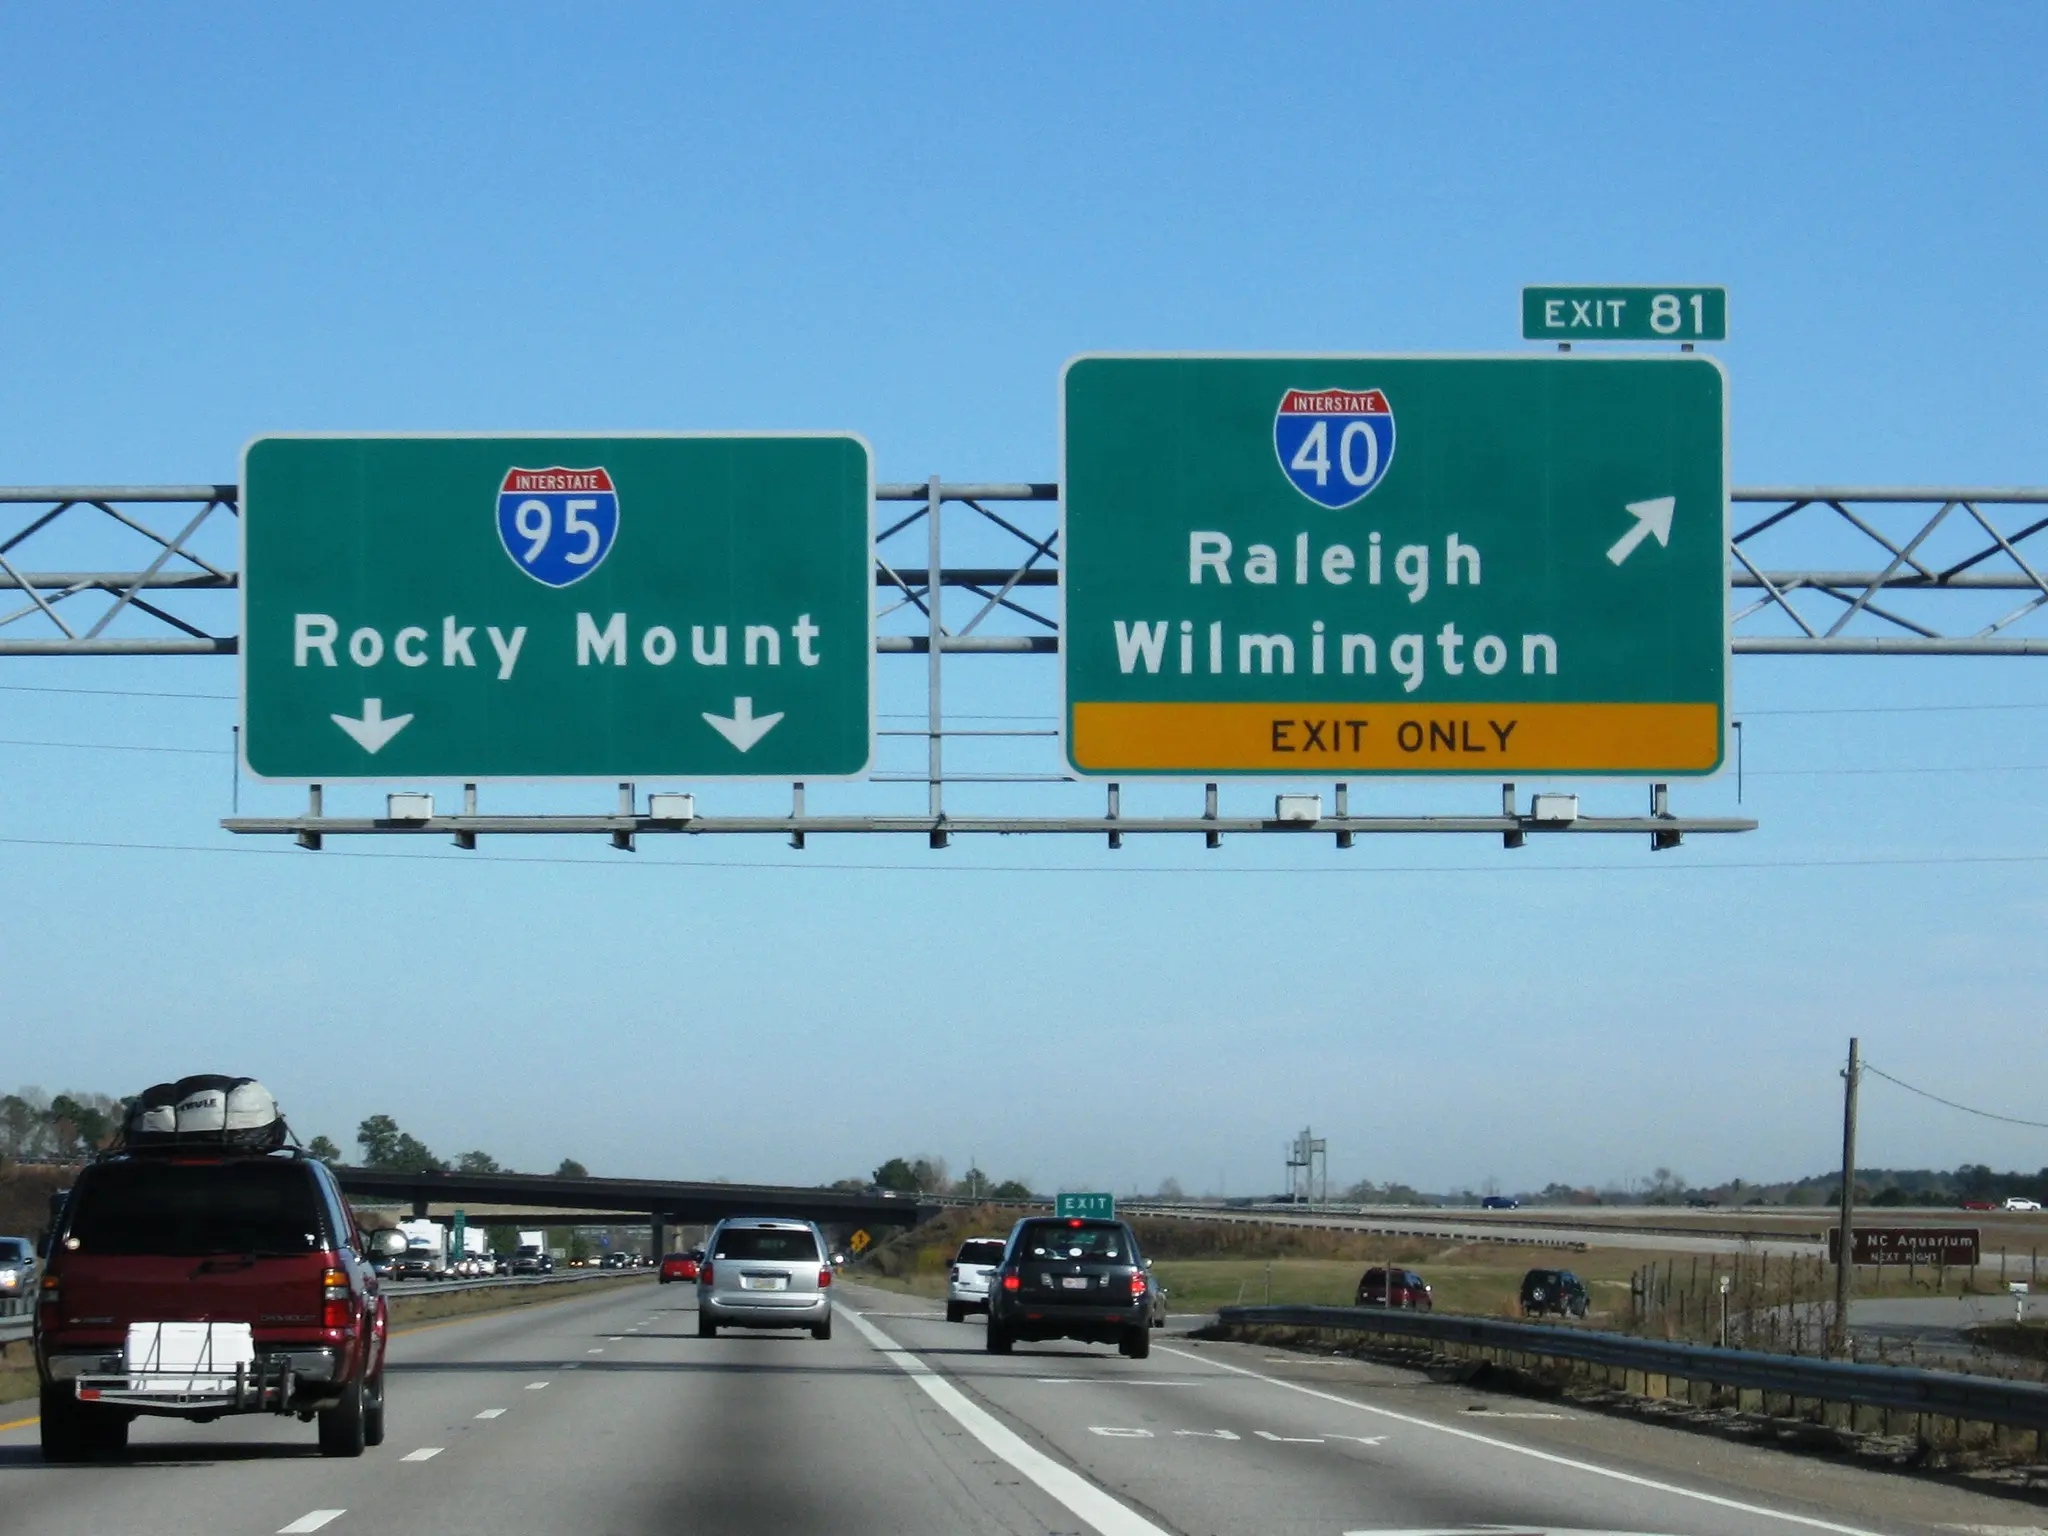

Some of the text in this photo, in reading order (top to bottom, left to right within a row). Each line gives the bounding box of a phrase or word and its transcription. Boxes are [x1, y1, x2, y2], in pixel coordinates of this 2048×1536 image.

[1544, 294, 1705, 333] EXIT 81
[1294, 397, 1376, 411] INTERSTATE
[1291, 421, 1378, 486] 40
[515, 475, 598, 489] INTERSTATE
[515, 500, 600, 565] 95
[1188, 530, 1482, 603] Raleigh
[293, 611, 821, 679] Rocky Mount
[1113, 618, 1558, 692] Wilmington
[1271, 719, 1519, 753] EXIT ONLY
[1065, 1198, 1107, 1209] EXIT
[1867, 1235, 1973, 1248] NC Aquarium
